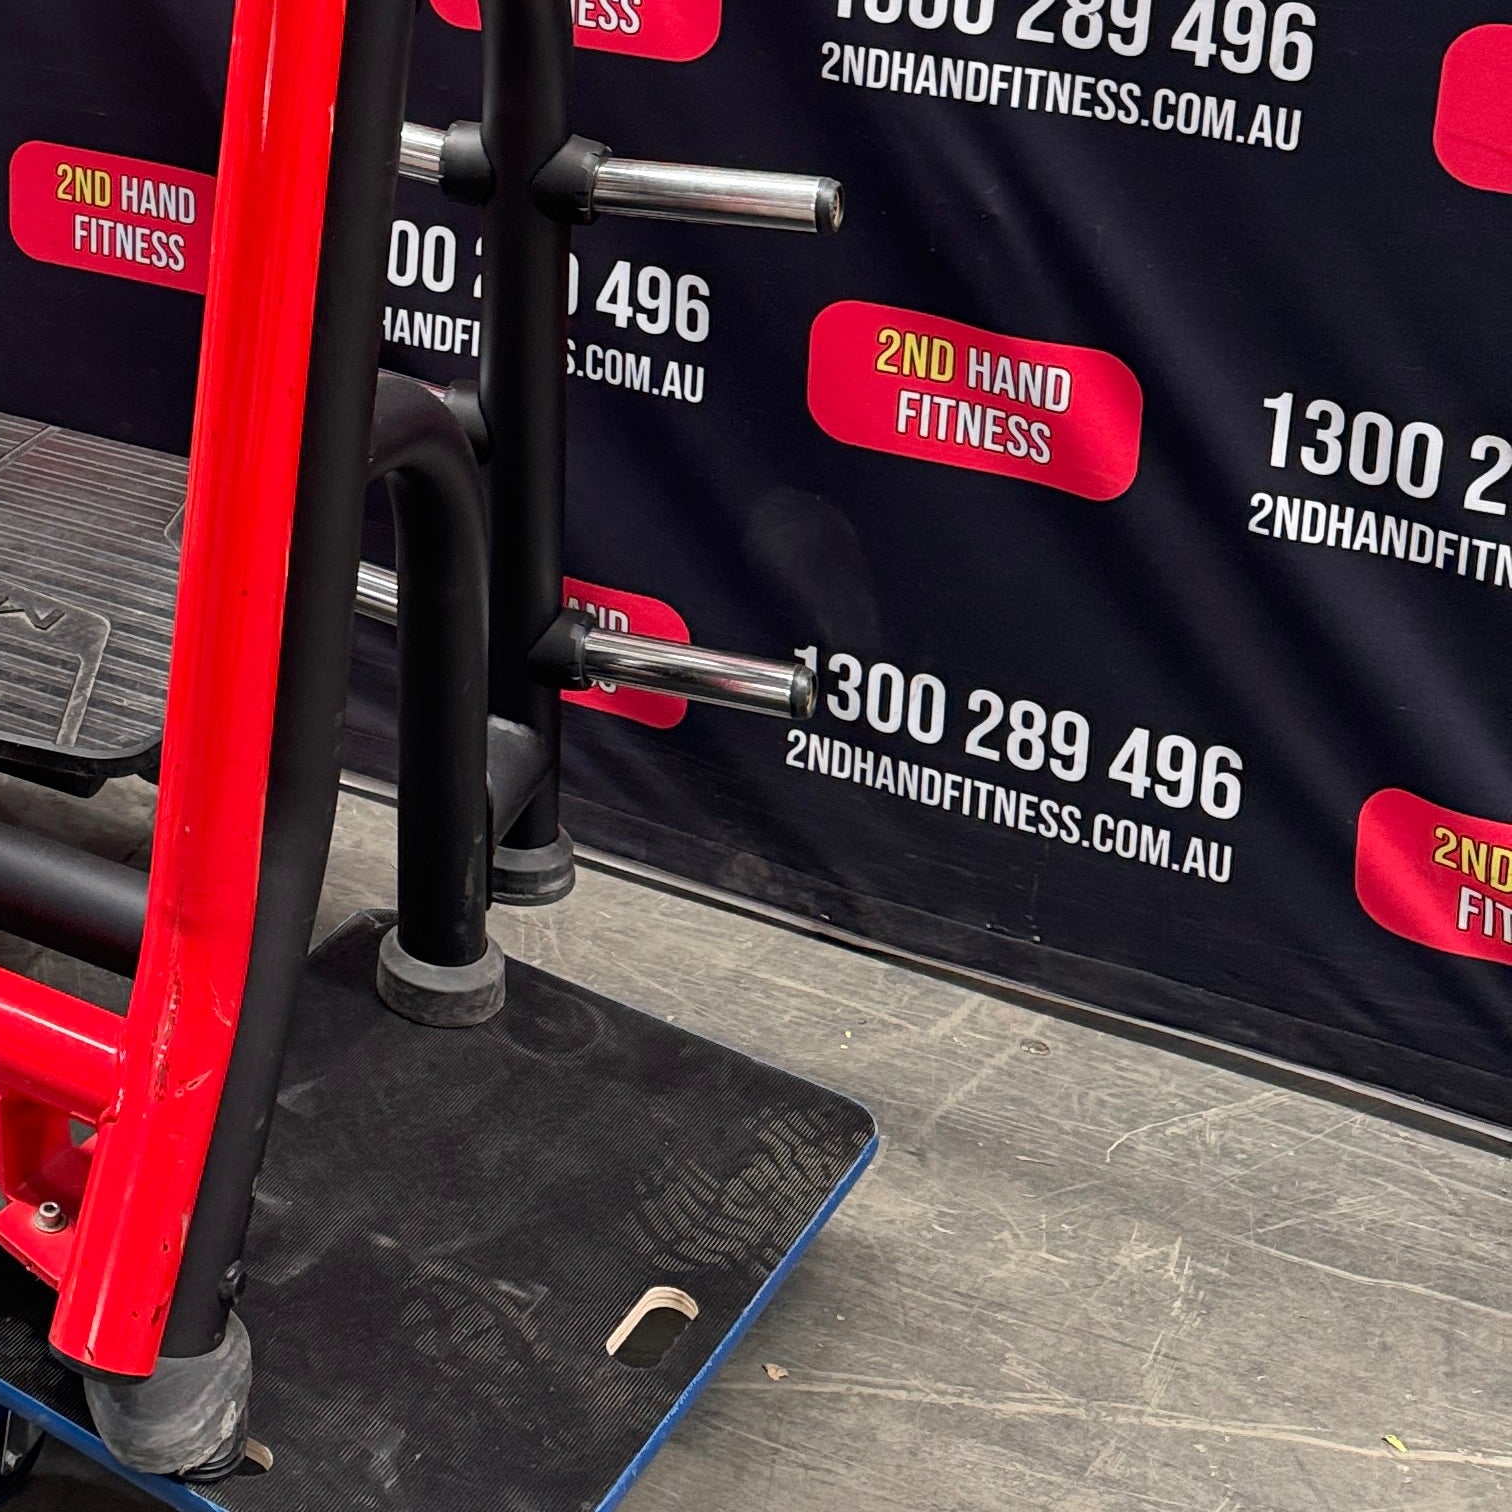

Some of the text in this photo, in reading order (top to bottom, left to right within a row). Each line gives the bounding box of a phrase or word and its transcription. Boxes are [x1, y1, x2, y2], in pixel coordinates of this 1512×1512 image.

[821, 41, 1302, 152] 2NDHANDFITNESS.COM.AU
[57, 163, 195, 224] 2ND HAND
[74, 214, 185, 271] FITNESS
[595, 260, 710, 343] 496
[876, 328, 1071, 412] 2ND HAND
[897, 390, 1051, 464] FITNESS
[1263, 392, 1444, 499] 1300
[964, 689, 1090, 782] 289
[1108, 727, 1243, 820] 496
[785, 728, 1232, 885] 2NDHANDFITNESS.COM.AU
[1432, 826, 1512, 894] 2ND
